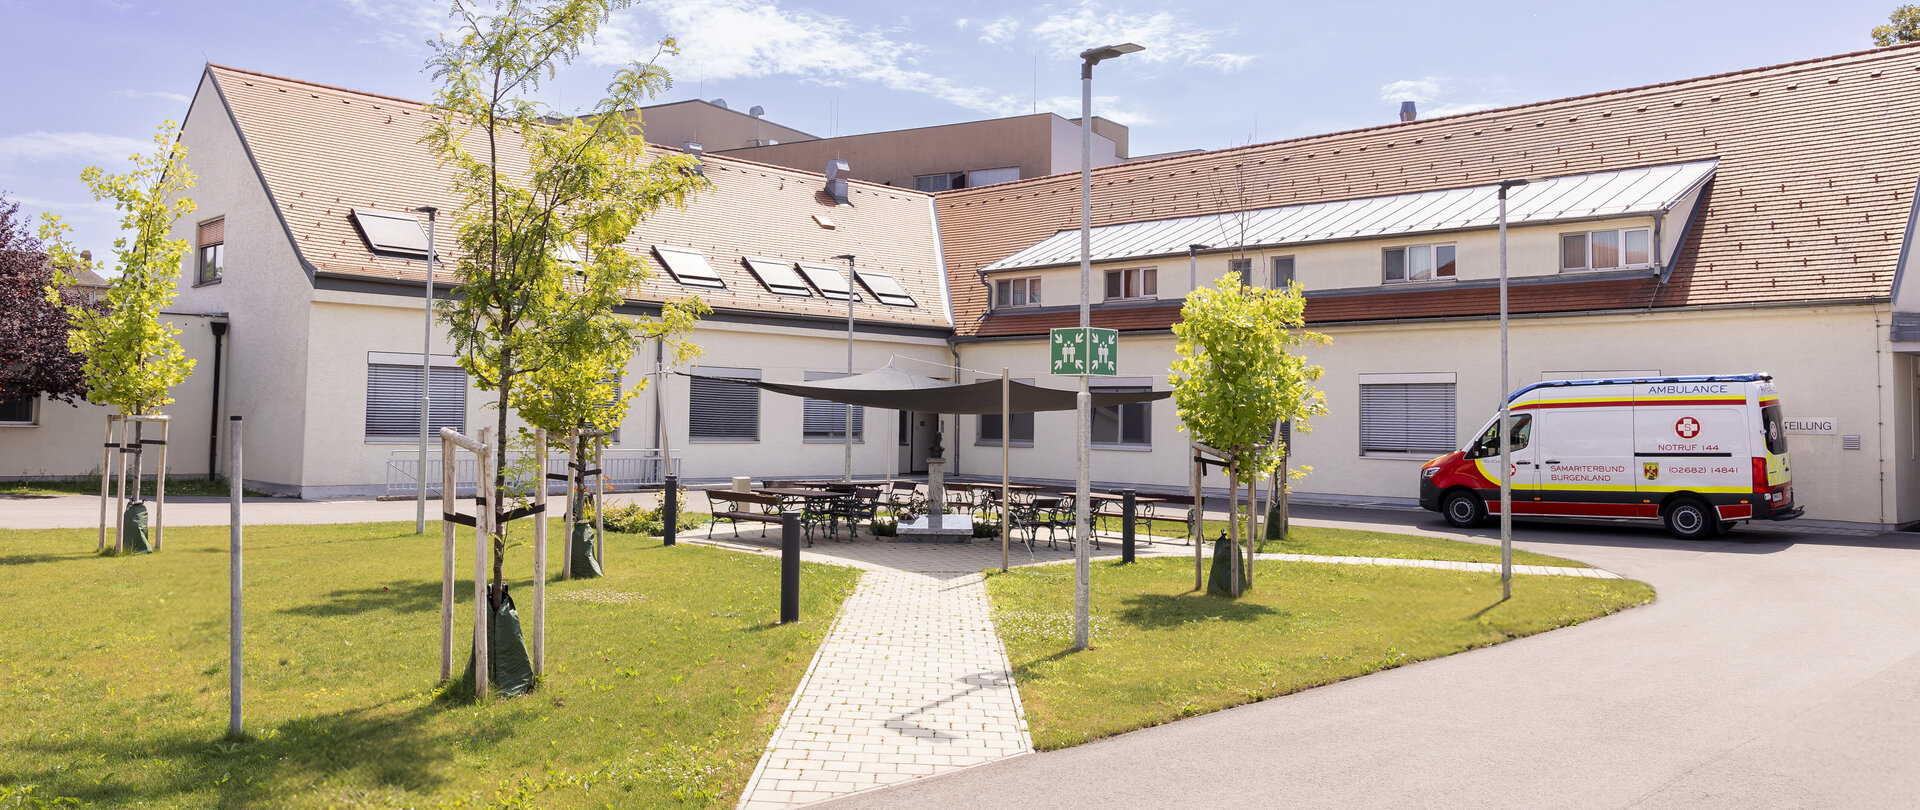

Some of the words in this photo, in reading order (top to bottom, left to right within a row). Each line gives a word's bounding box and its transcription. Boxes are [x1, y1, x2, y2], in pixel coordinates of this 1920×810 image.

[1648, 384, 1728, 394] AMBULANCE
[1684, 423, 1692, 432] S
[1550, 465, 1625, 473] SAMARITERBUND
[1668, 466, 1707, 474] (02682)
[1711, 466, 1738, 474] 14841
[1551, 474, 1611, 482] BURGENLAND
